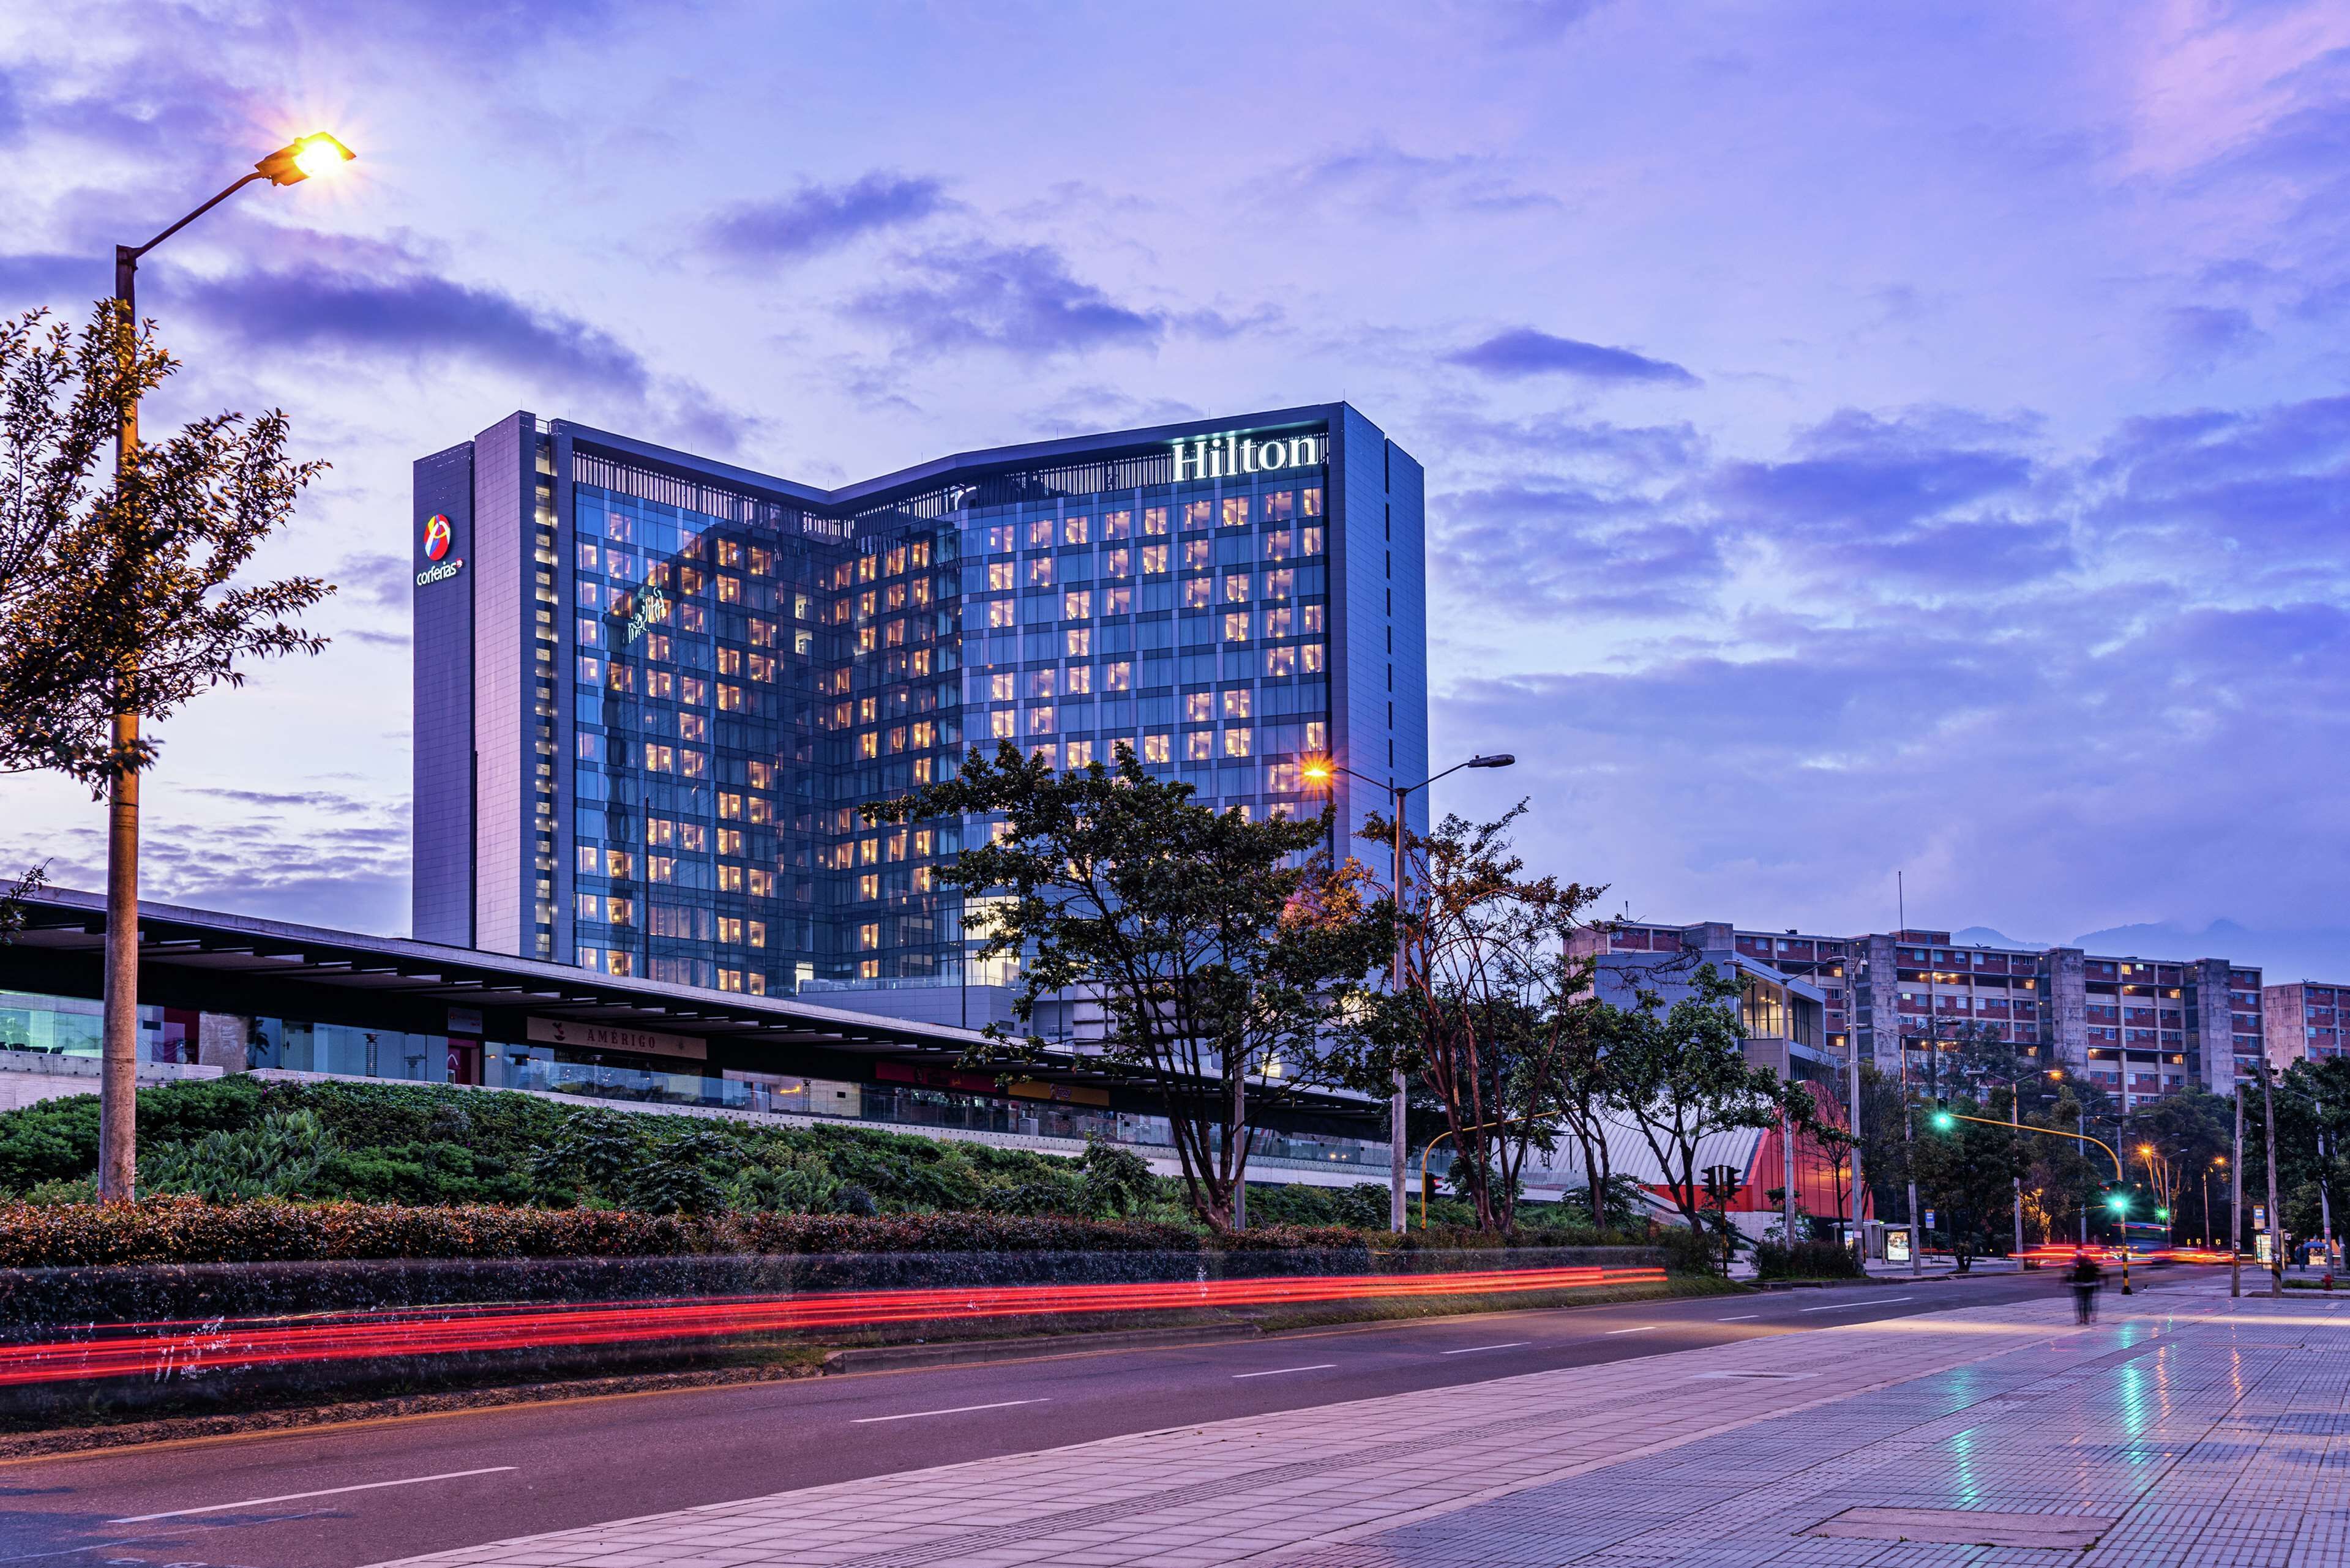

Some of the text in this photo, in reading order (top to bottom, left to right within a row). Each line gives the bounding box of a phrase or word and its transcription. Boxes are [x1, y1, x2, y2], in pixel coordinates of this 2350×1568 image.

[1172, 436, 1317, 482] Hilton
[416, 561, 457, 586] corferias
[587, 1029, 656, 1048] AMÉRIGO
